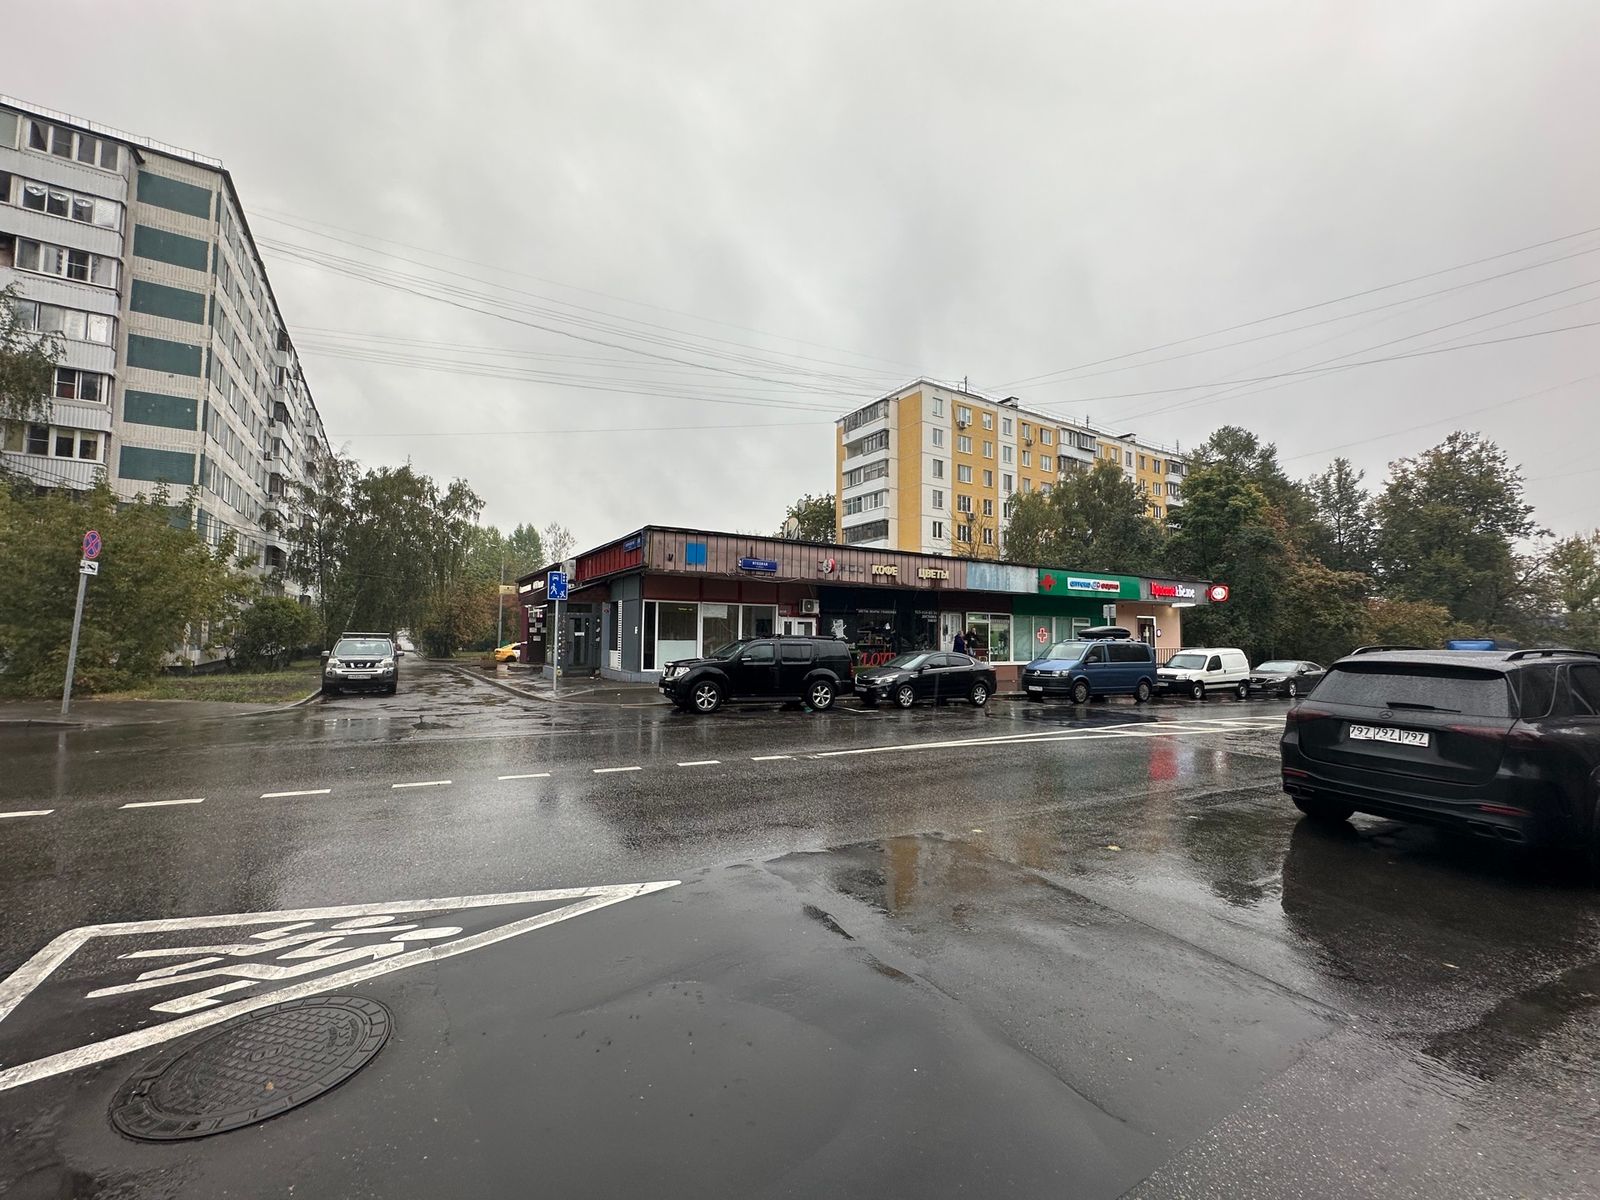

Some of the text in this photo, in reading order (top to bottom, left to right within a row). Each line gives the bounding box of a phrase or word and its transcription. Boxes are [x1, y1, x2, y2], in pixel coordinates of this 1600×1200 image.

[872, 564, 898, 576] КОФЕ
[918, 568, 949, 580] ЦВЕТЫ
[1350, 726, 1425, 742] 797 797 797
